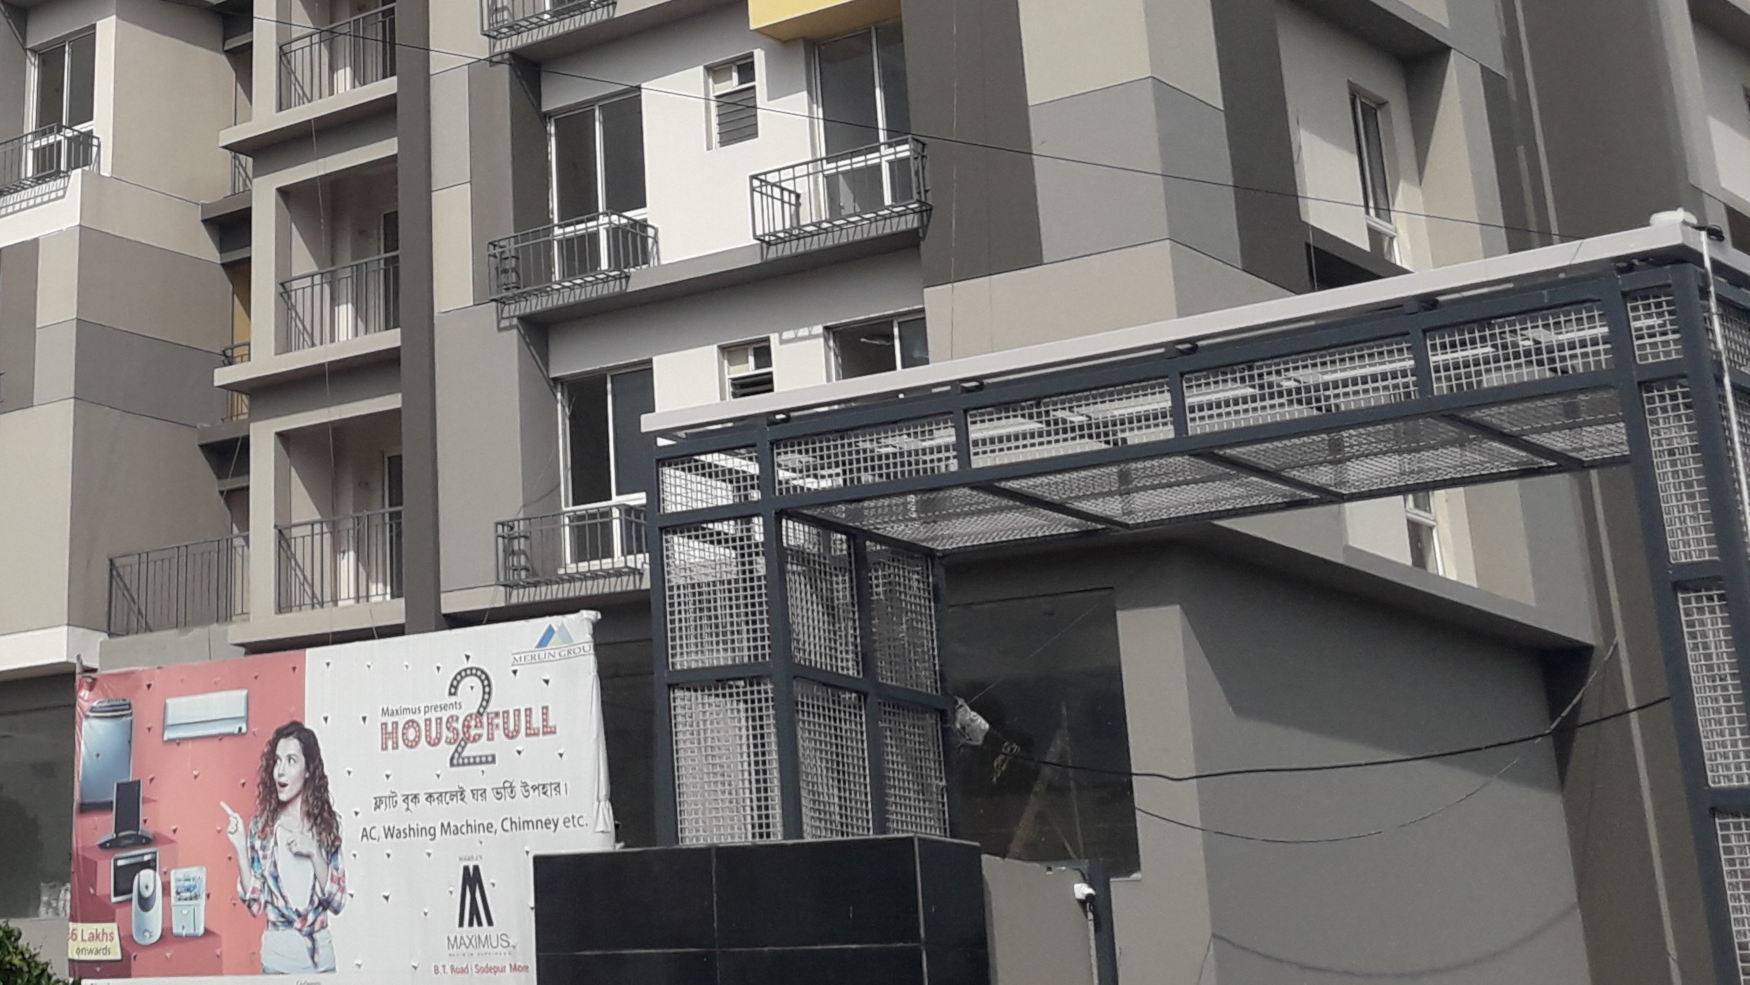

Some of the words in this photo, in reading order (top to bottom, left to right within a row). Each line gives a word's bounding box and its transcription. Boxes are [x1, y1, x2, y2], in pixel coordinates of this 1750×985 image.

[512, 651, 556, 663] MERLIN
[558, 644, 592, 658] GROU
[381, 704, 421, 717] Maximus
[424, 701, 462, 715] presents
[402, 792, 420, 813] বুক
[424, 785, 467, 806] করলেই
[470, 788, 487, 803] ঘর
[491, 779, 516, 801] ভর্তি
[361, 826, 380, 843] AC,
[383, 823, 436, 841] Washing
[440, 819, 497, 836] Machine,
[500, 815, 559, 833] Chimney
[563, 814, 588, 827] etc.
[81, 928, 115, 943] Lakhs
[447, 933, 510, 950] MAXIMUS
[75, 945, 111, 956] onwards
[450, 964, 469, 974] Road
